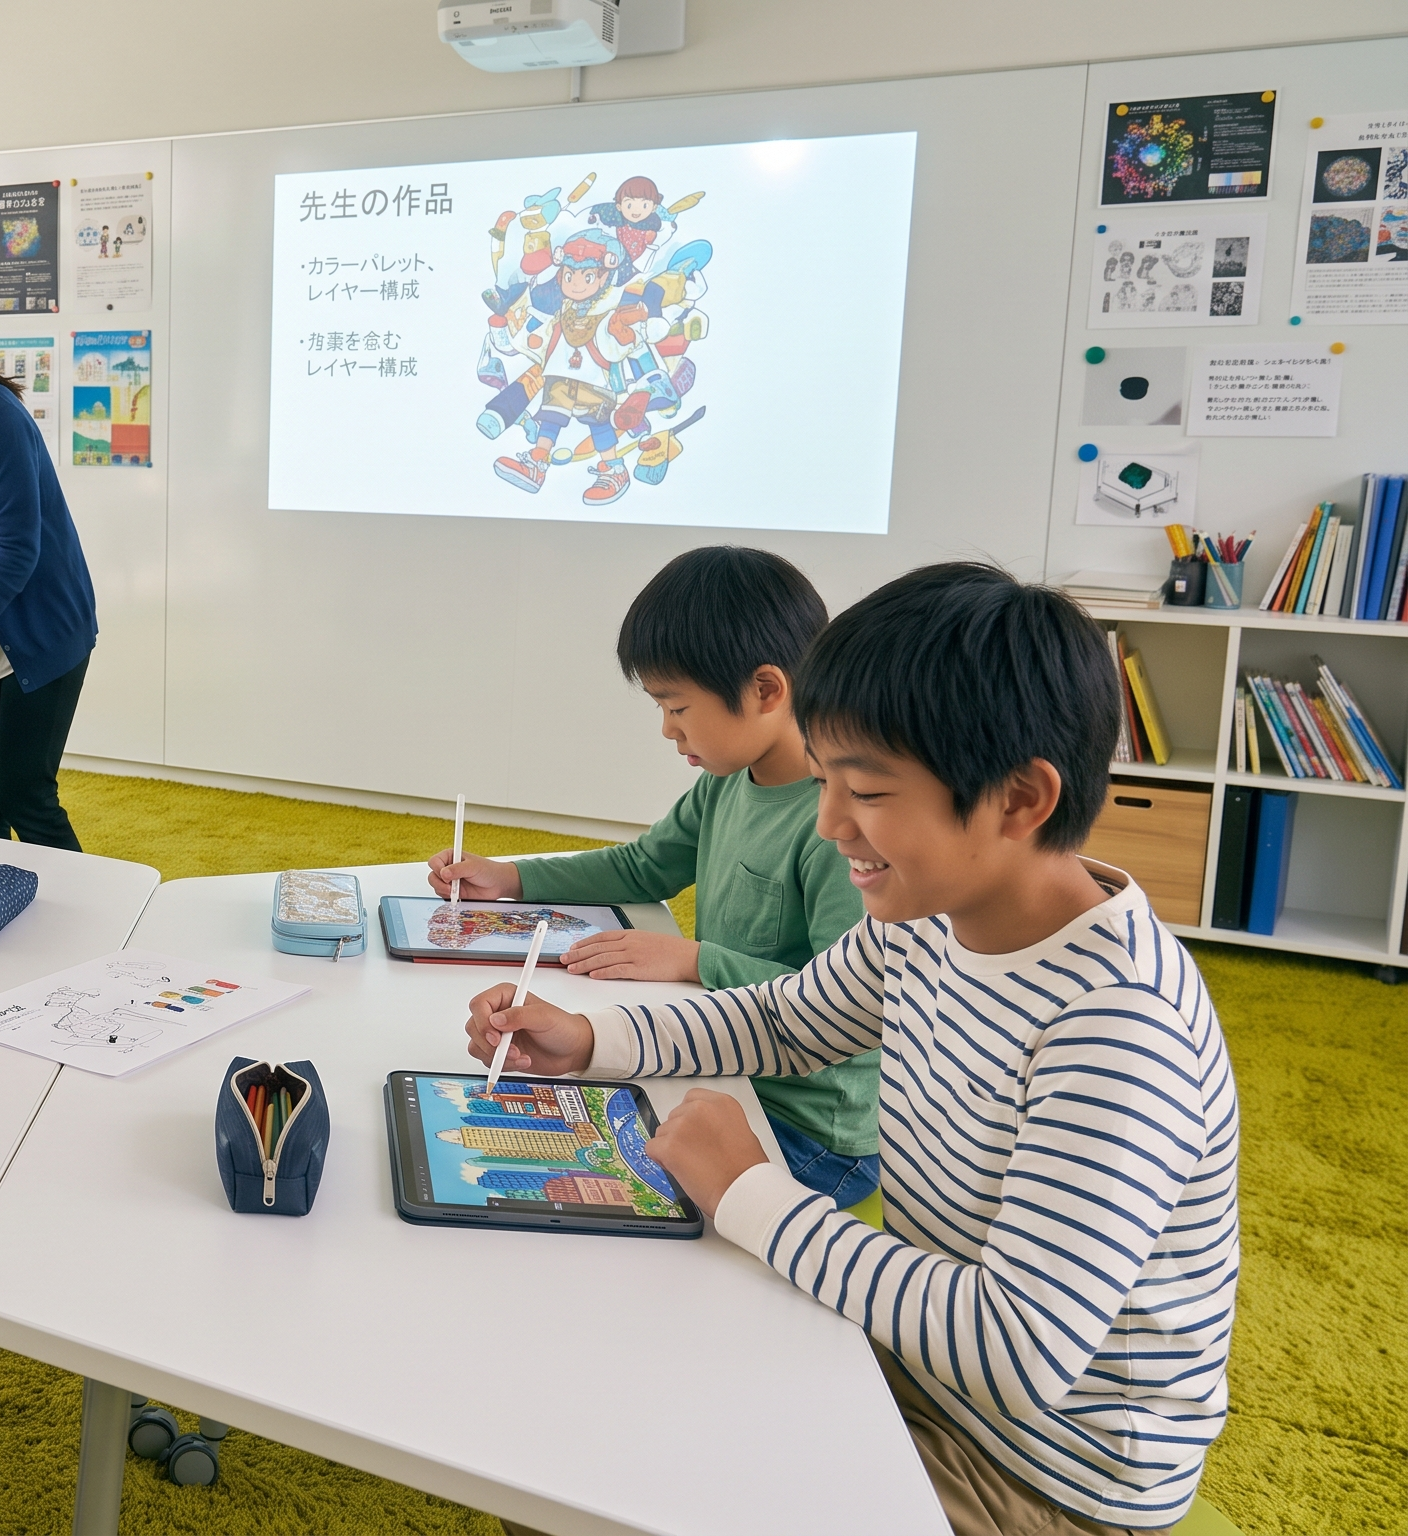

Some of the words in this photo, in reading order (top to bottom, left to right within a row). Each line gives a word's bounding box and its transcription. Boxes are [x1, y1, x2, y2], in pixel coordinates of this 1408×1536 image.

[299, 182, 453, 223] 先生の作品
[308, 279, 420, 302] レイヤー構成
[307, 356, 418, 378] レイヤー構成
